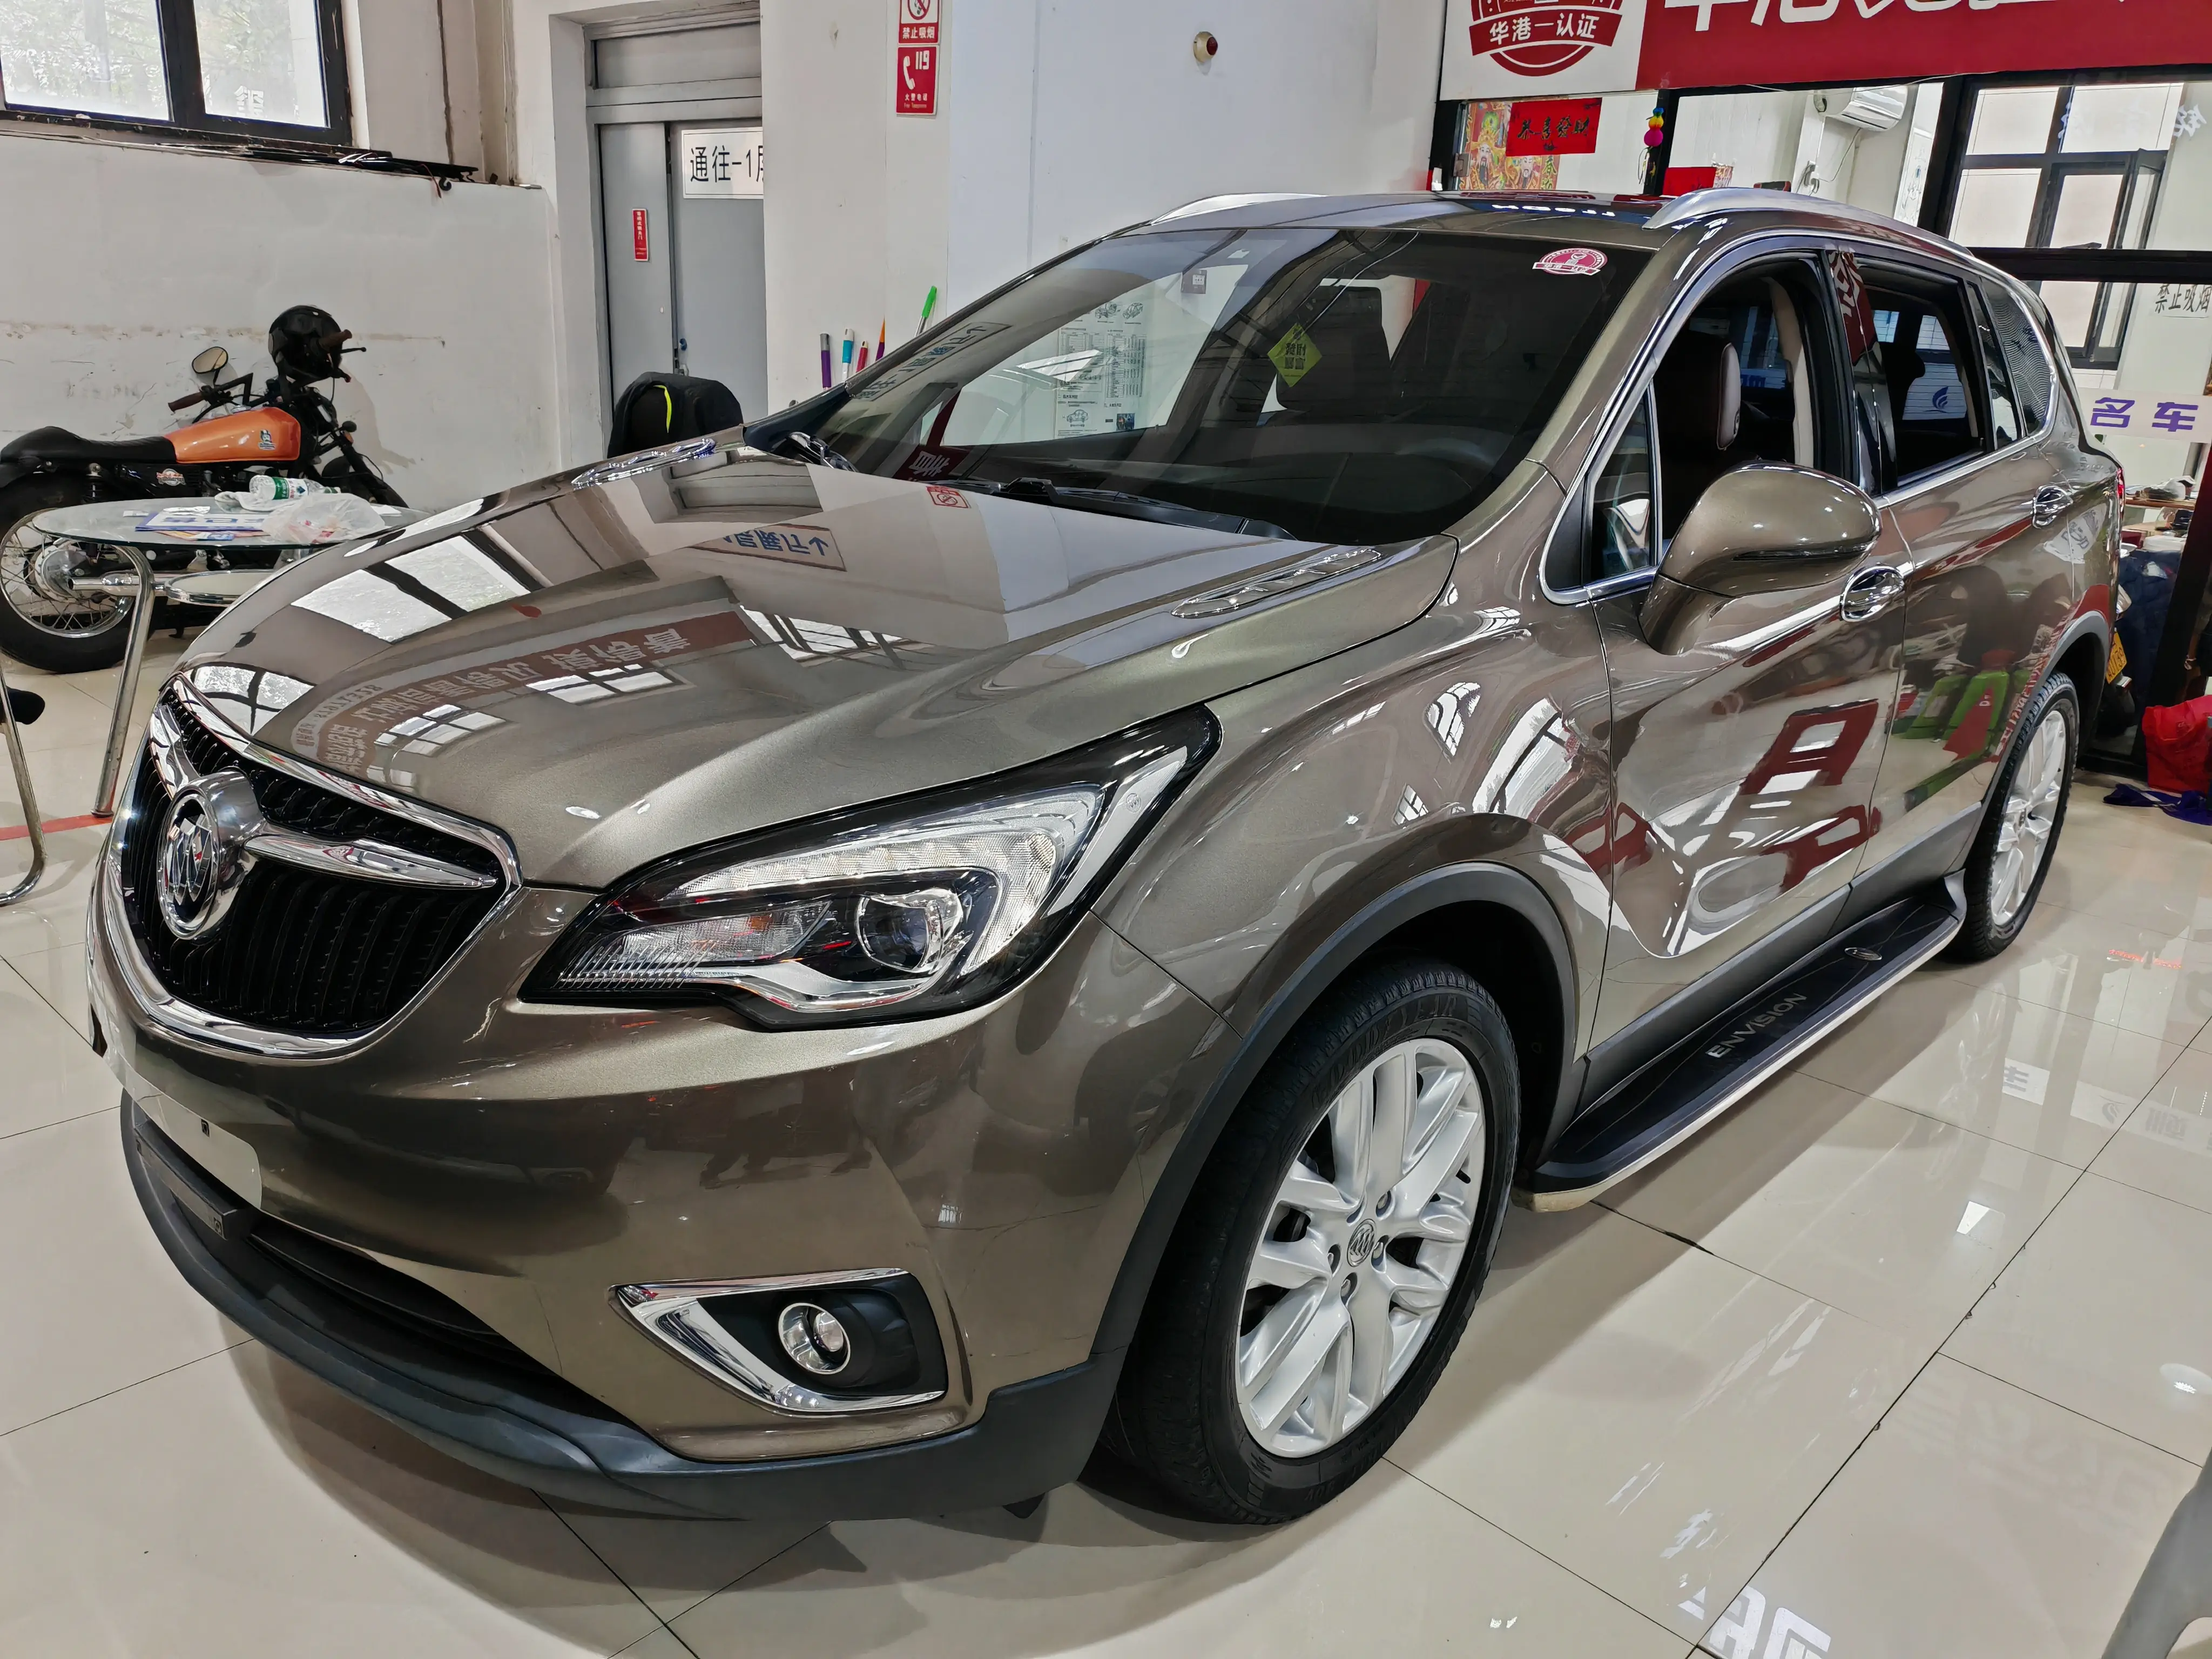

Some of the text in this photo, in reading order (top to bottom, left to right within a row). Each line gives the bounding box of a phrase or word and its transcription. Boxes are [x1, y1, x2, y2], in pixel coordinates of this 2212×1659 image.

[902, 26, 935, 39] 禁止吸烟
[1489, 12, 1600, 45] 华港一认证
[915, 50, 930, 70] 119
[2090, 397, 2198, 432] 名车
[1705, 993, 1808, 1058] ENVISION
